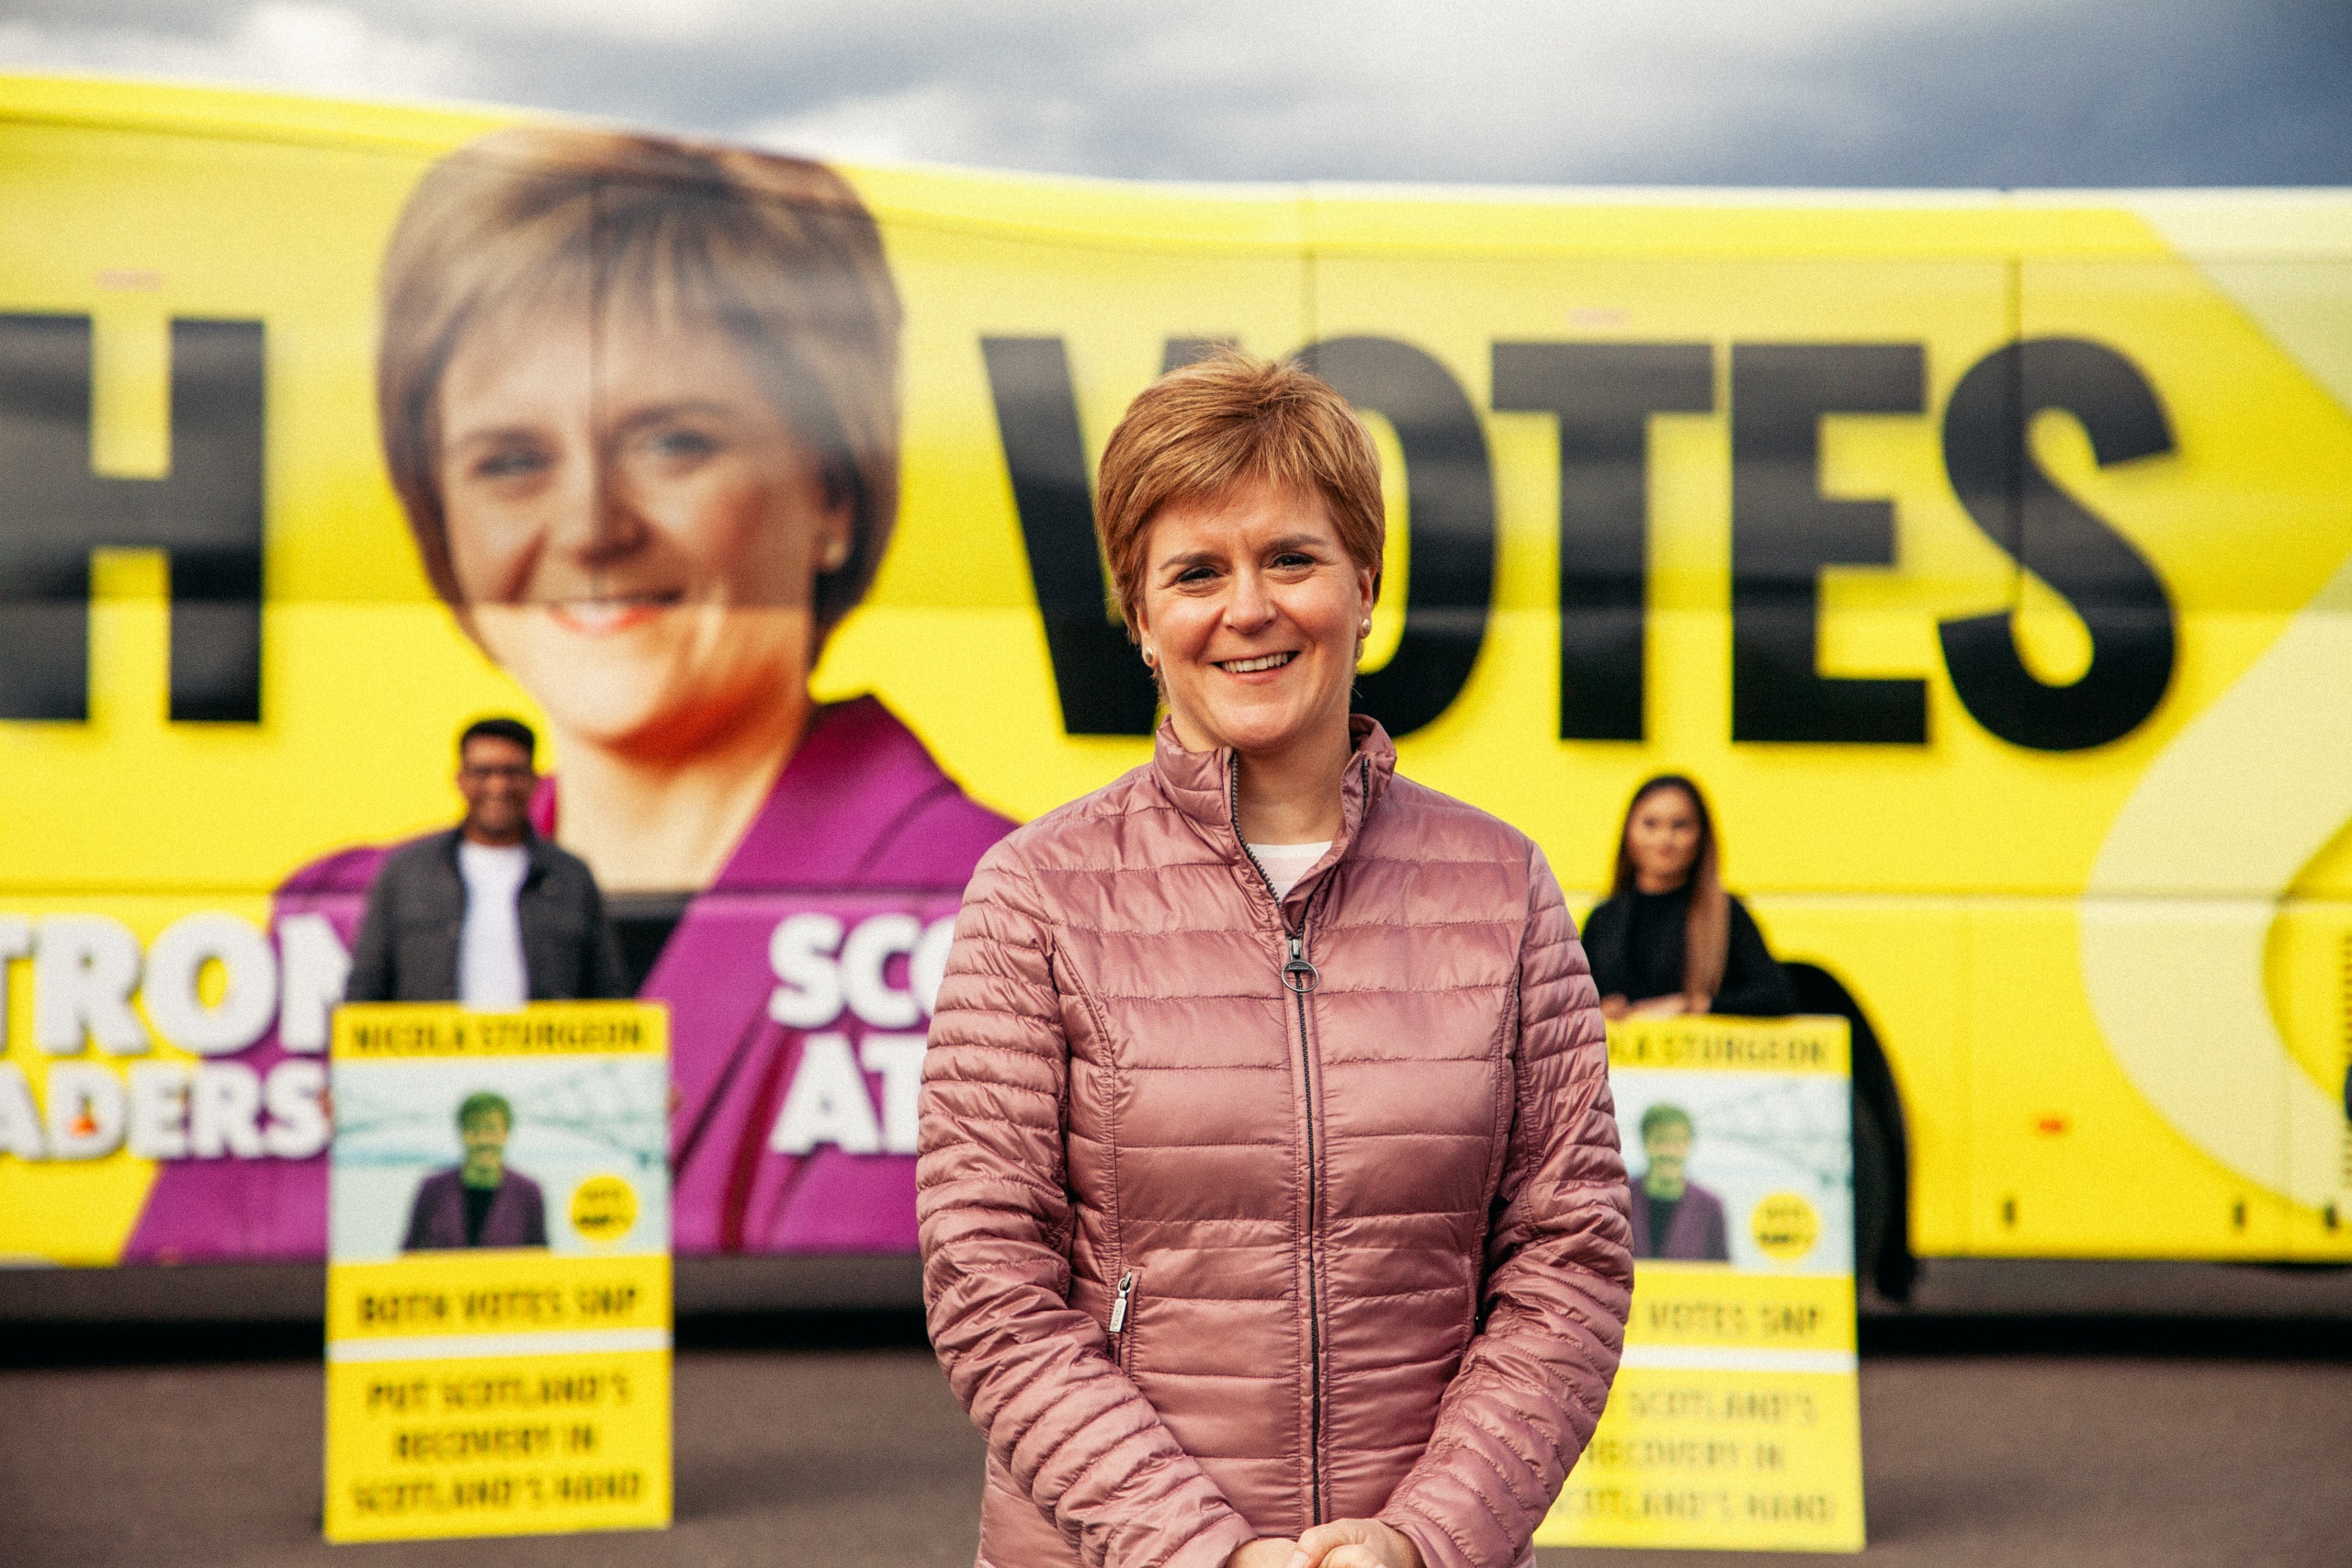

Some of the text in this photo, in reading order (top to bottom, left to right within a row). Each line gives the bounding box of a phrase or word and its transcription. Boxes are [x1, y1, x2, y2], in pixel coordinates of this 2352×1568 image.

[979, 334, 2179, 751] VOTES
[353, 1018, 642, 1054] NICOLA STURGEON
[1664, 1034, 1829, 1066] STURGEON
[359, 1285, 638, 1326] BOTH VOTES SNP
[1649, 1302, 1749, 1332] VOTES
[1760, 1303, 1822, 1337] SNP
[369, 1374, 629, 1412] PUT SCOTLAND'S
[392, 1424, 595, 1461] RECOVERY IN
[352, 1477, 542, 1514] SCOTLAND'S
